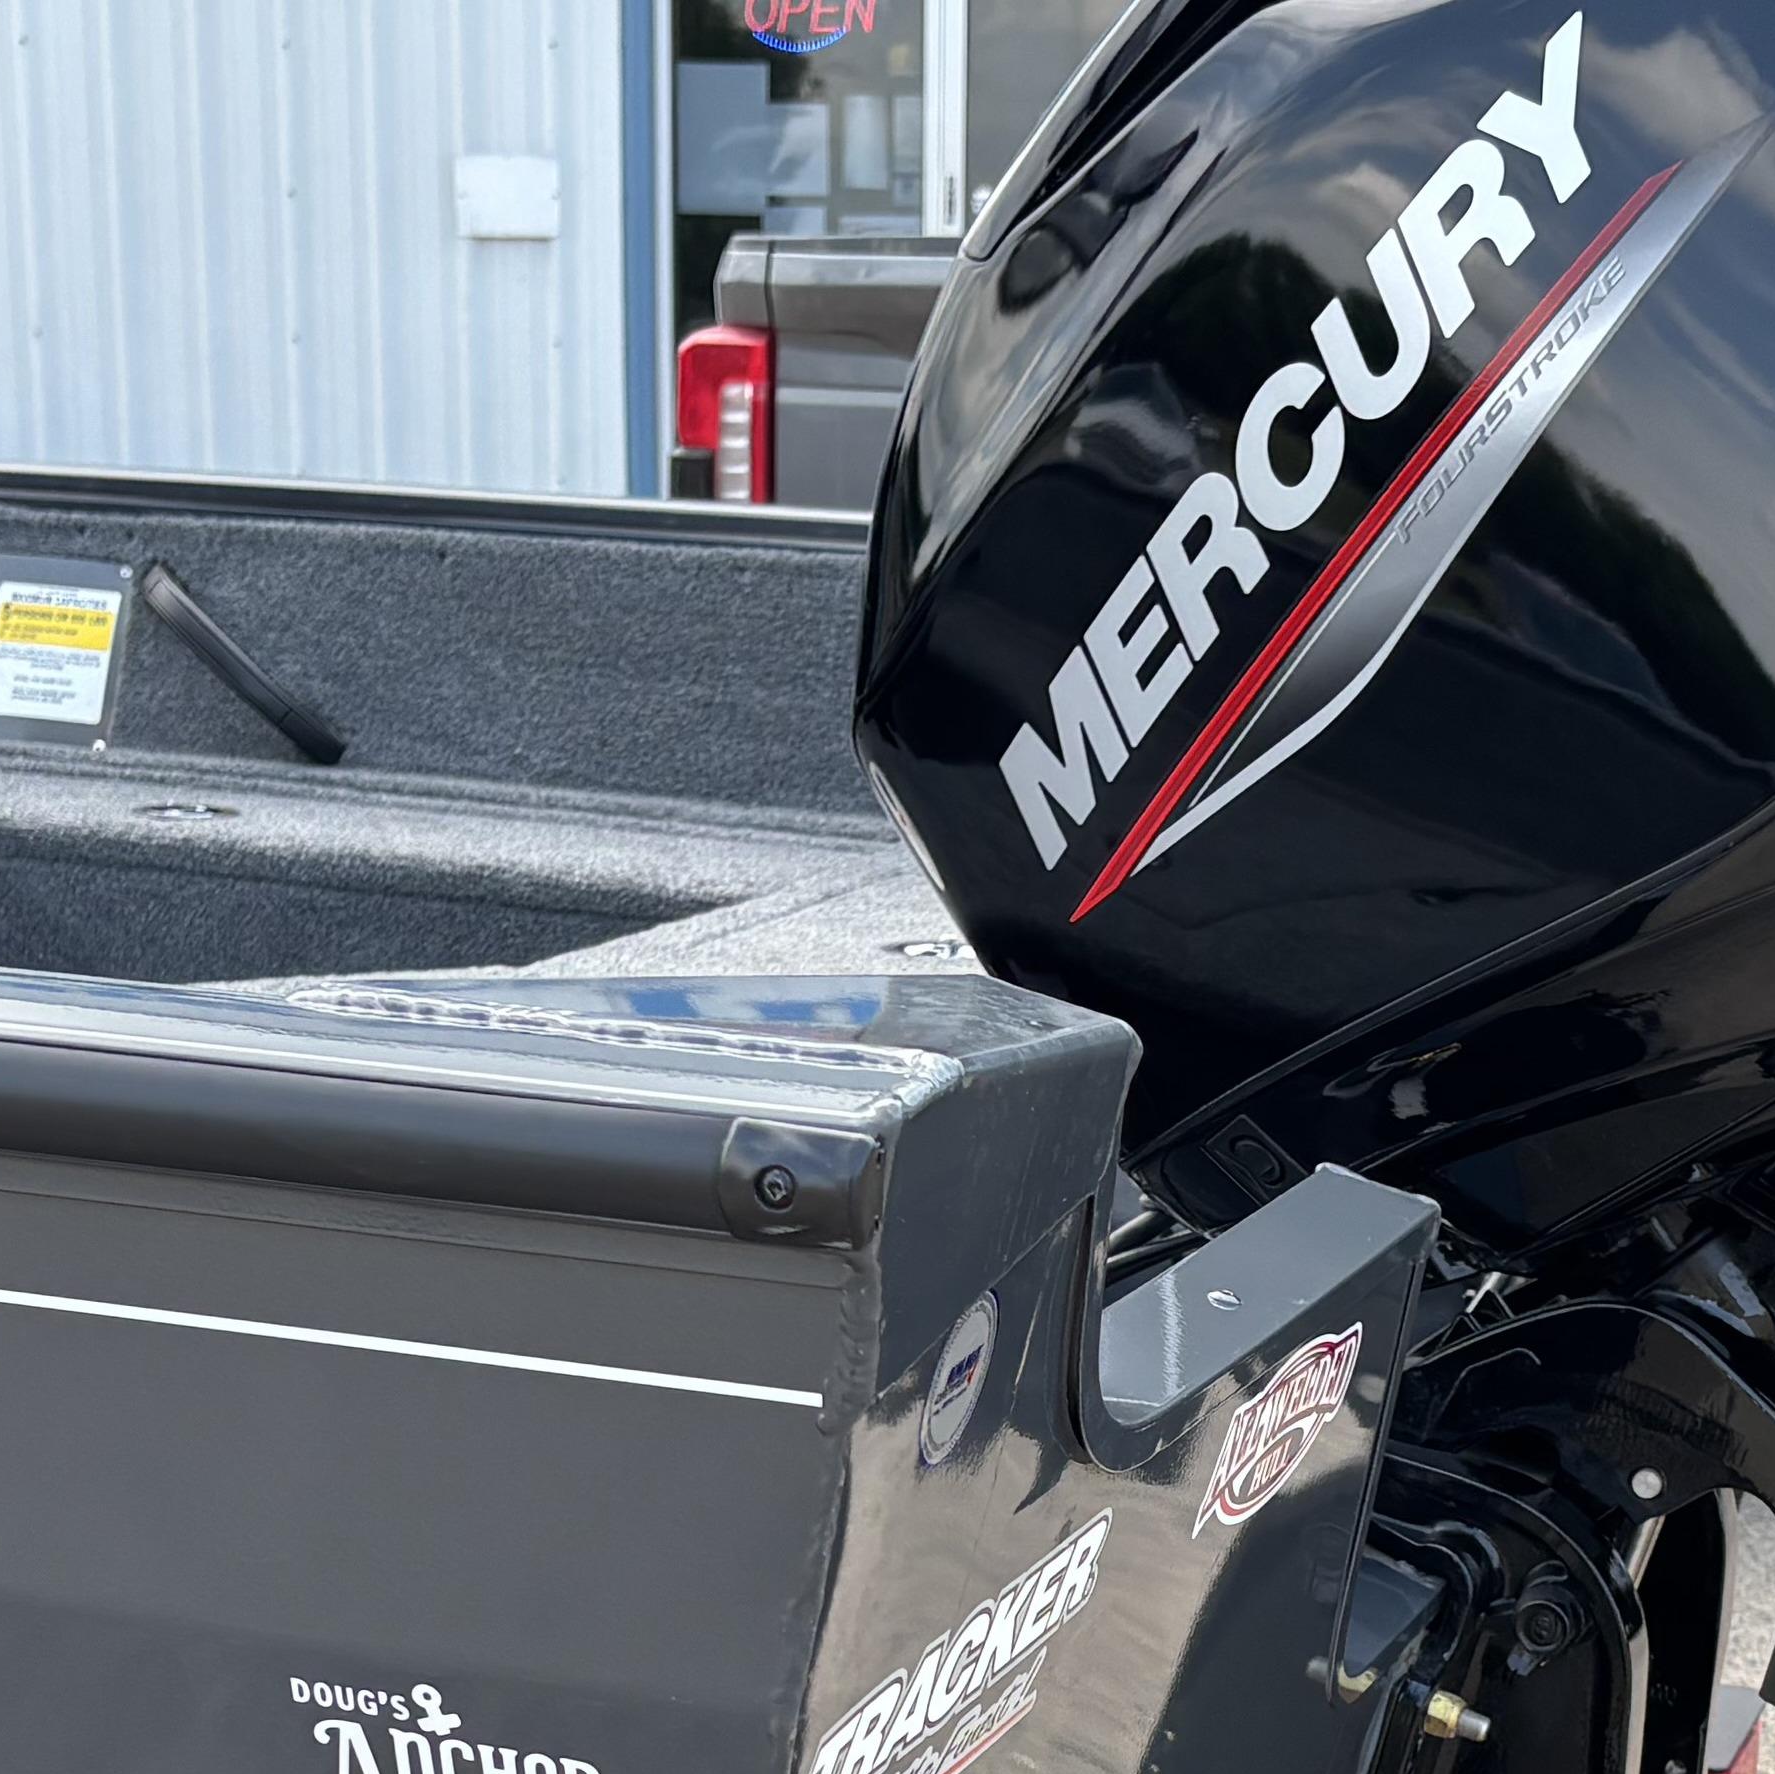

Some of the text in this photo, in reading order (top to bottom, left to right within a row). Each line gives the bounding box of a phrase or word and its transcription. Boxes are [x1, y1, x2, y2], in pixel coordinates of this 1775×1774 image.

[745, 0, 876, 33] OPEN
[1393, 254, 1626, 545] FOURSTROKE
[998, 9, 1593, 871] MERCURY
[1247, 1436, 1294, 1498] HULL
[289, 1676, 411, 1722] DOUG'S
